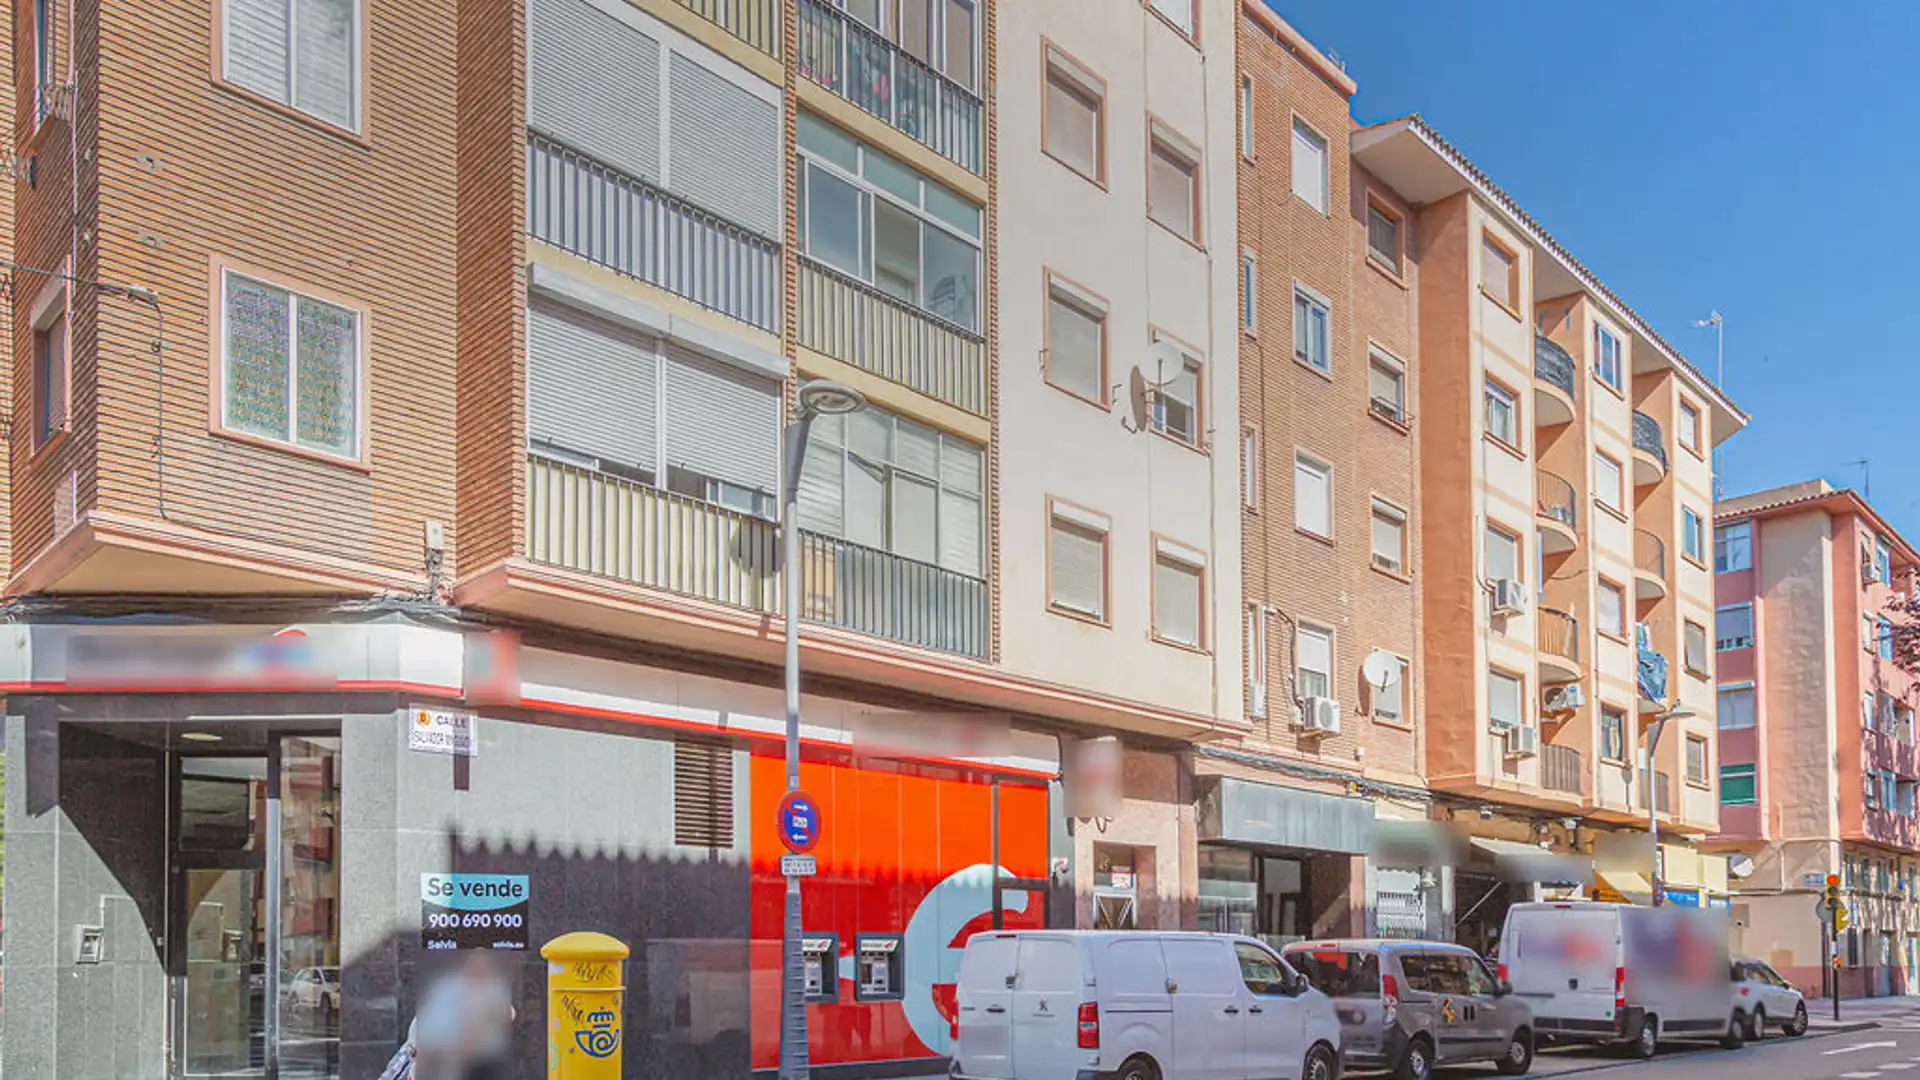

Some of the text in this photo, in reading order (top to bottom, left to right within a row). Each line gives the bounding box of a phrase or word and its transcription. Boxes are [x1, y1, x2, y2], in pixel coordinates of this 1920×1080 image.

[436, 715, 467, 729] CALLE
[427, 877, 523, 897] Se vende
[428, 913, 523, 929] 900 690 900
